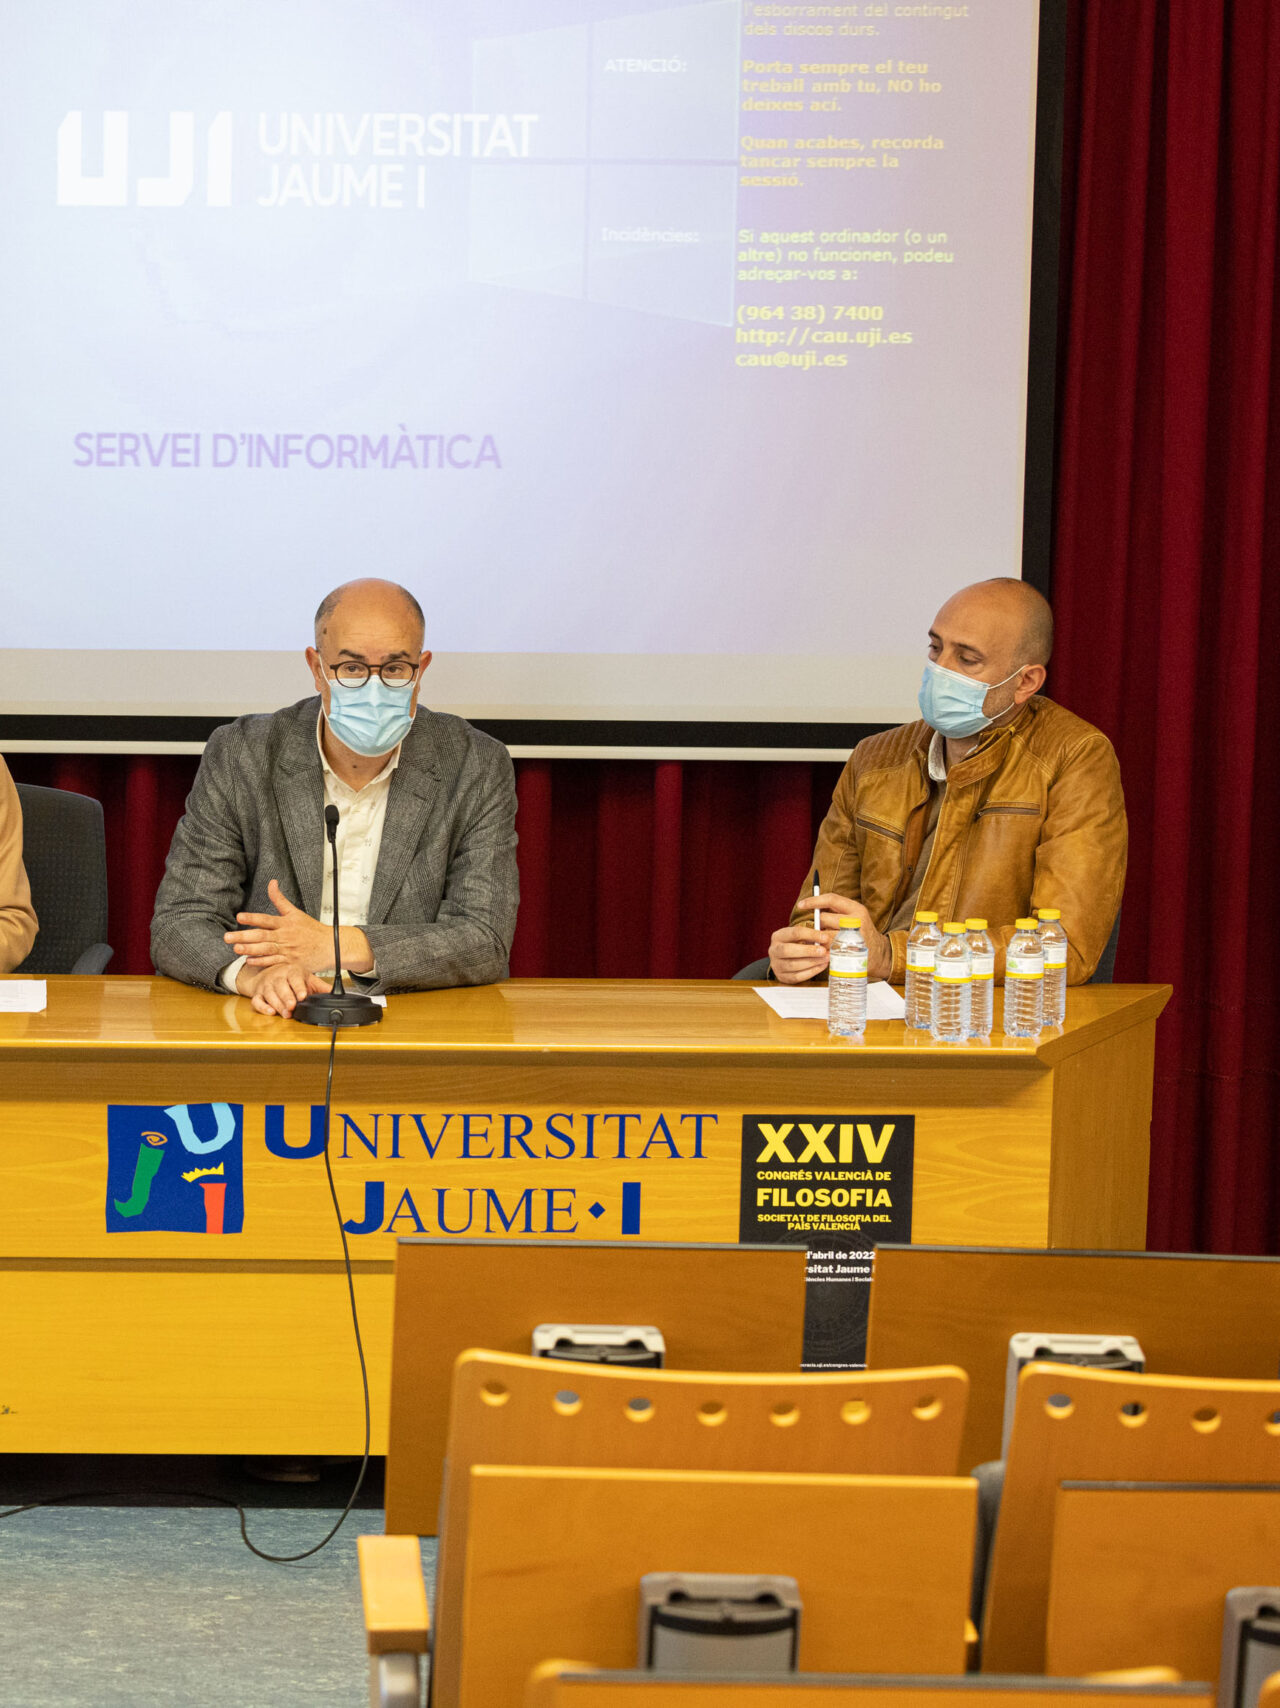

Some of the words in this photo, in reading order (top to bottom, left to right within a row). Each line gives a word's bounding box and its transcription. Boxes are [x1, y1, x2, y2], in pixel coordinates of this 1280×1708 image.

[864, 3, 889, 17] del
[894, 3, 969, 20] contingut
[784, 22, 833, 35] discos
[839, 22, 880, 36] durs.
[604, 57, 687, 72] ATENCIÓ:
[742, 61, 792, 73] Porta
[799, 62, 869, 76] sempre
[875, 60, 893, 73] el
[898, 61, 928, 73] teu
[742, 79, 804, 92] treball
[812, 79, 851, 92] amb
[858, 80, 881, 94] tu,
[888, 80, 912, 92] NO
[919, 79, 942, 92] ho
[742, 97, 803, 111] deixes
[258, 112, 539, 158] UNIVERSITAT
[741, 136, 788, 151] Quan
[795, 136, 865, 151] acabes,
[872, 135, 944, 149] recorda
[56, 110, 232, 207] UJI
[740, 155, 800, 168] tancar
[807, 157, 877, 170] sempre
[882, 154, 899, 168] la
[257, 163, 404, 207] JAUME
[417, 165, 425, 209] I
[739, 172, 804, 187] sessió.
[602, 228, 699, 243] Incidències:
[738, 229, 753, 243] Si
[759, 230, 814, 247] aquest
[820, 229, 899, 243] ordinador
[904, 229, 920, 246] (o
[927, 232, 947, 243] un
[737, 248, 782, 264] altre)
[788, 251, 808, 262] no
[814, 248, 897, 264] funcionen,
[903, 249, 954, 265] podeu
[737, 266, 837, 282] adreçar-vos
[841, 269, 858, 281] a:
[736, 305, 785, 321] (964
[791, 305, 826, 321] 38)
[832, 306, 883, 321] 7400
[735, 327, 913, 347] http://cau.uji.es
[735, 351, 848, 369] cau@uji.es
[73, 432, 200, 468] SERVEI
[213, 423, 503, 470] D'INFORMÀTICA
[264, 1104, 719, 1160] UNIVERSITAT
[756, 1123, 896, 1164] XXIV
[756, 1169, 813, 1180] CONGRÉS
[814, 1169, 873, 1181] VALENCIÀ
[875, 1172, 891, 1181] DE
[756, 1188, 893, 1207] FILOSOFIA
[621, 1181, 641, 1235] I
[757, 1214, 805, 1222] SOCIETAT
[806, 1214, 820, 1222] DE
[821, 1214, 871, 1223] FILOSOFIA
[872, 1214, 892, 1223] DEL
[787, 1221, 811, 1231] PAÍS
[812, 1221, 861, 1231] VALENCIÀ
[835, 1251, 848, 1260] de
[849, 1251, 876, 1260] 2022
[835, 1265, 870, 1273] Jaume
